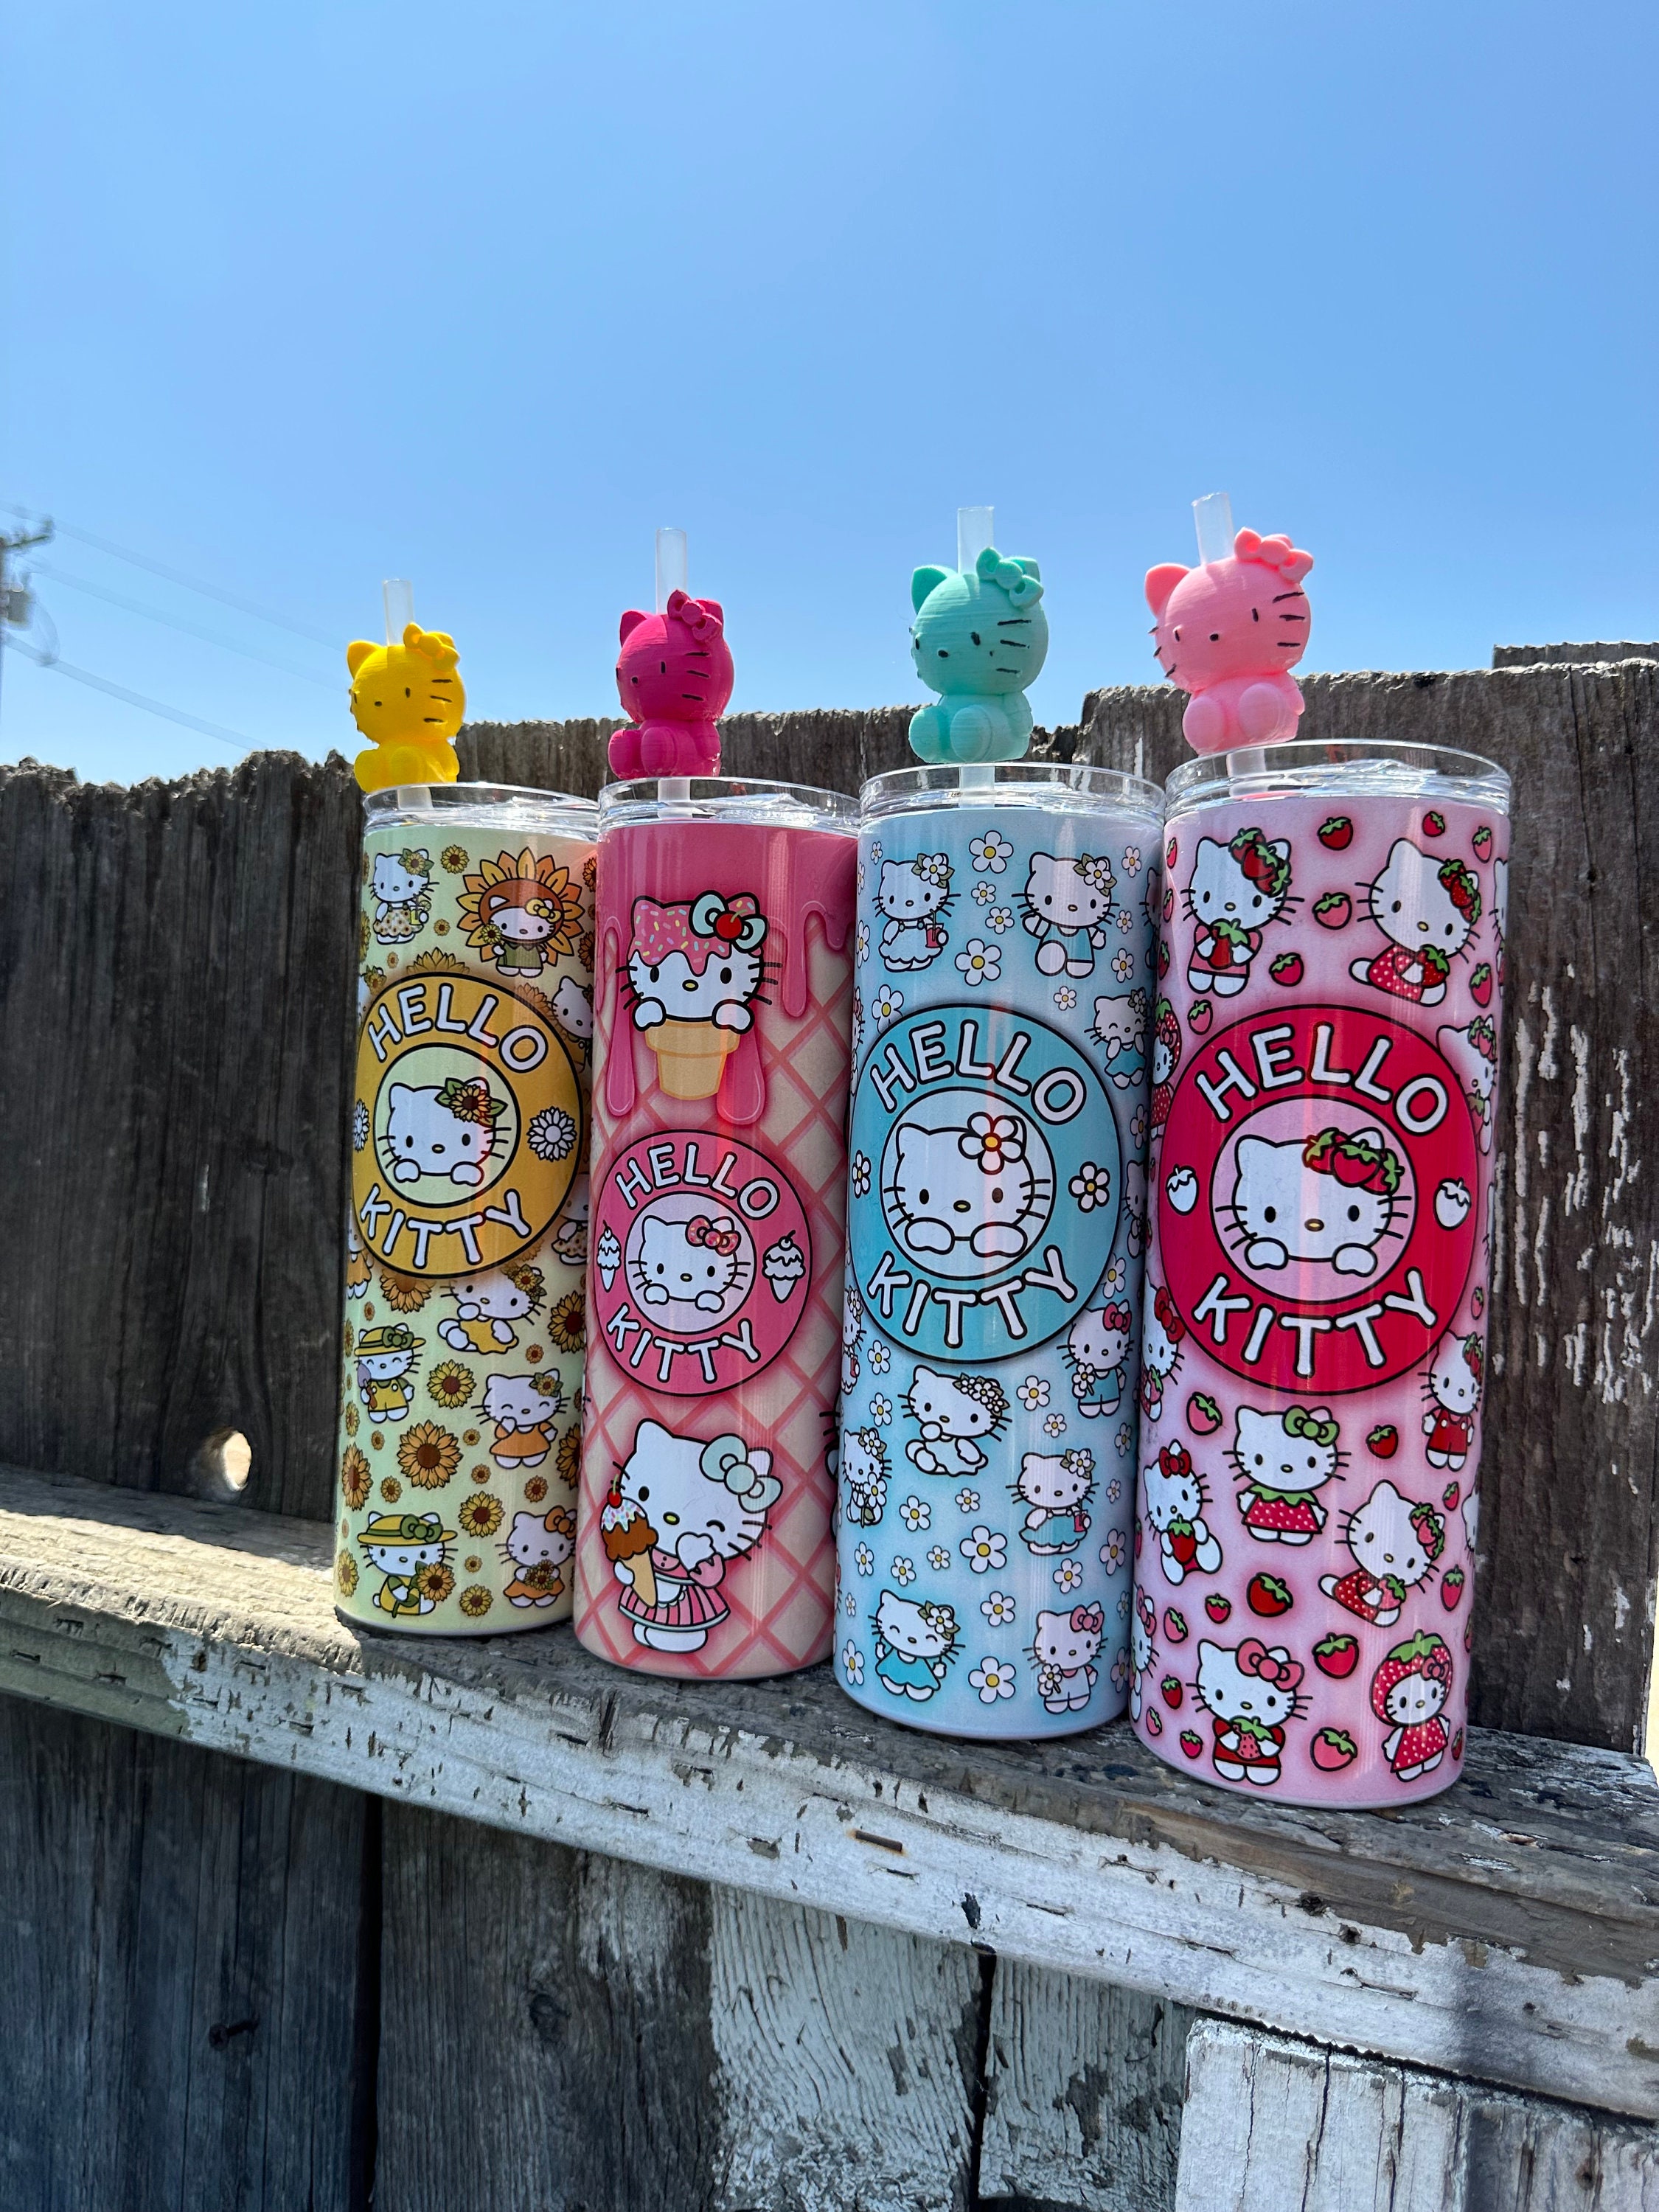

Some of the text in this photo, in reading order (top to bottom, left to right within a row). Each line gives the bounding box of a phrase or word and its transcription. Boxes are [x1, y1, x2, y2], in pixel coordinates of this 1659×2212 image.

[367, 983, 549, 1074] HELLO
[870, 1019, 1087, 1126] HELLO
[1194, 1020, 1449, 1135] HELLO
[360, 1185, 532, 1270] KITTY
[616, 1141, 780, 1221] HELLO
[608, 1302, 762, 1383] KITTY
[866, 1245, 1078, 1348] KITTY
[1193, 1267, 1438, 1377] KITTY
